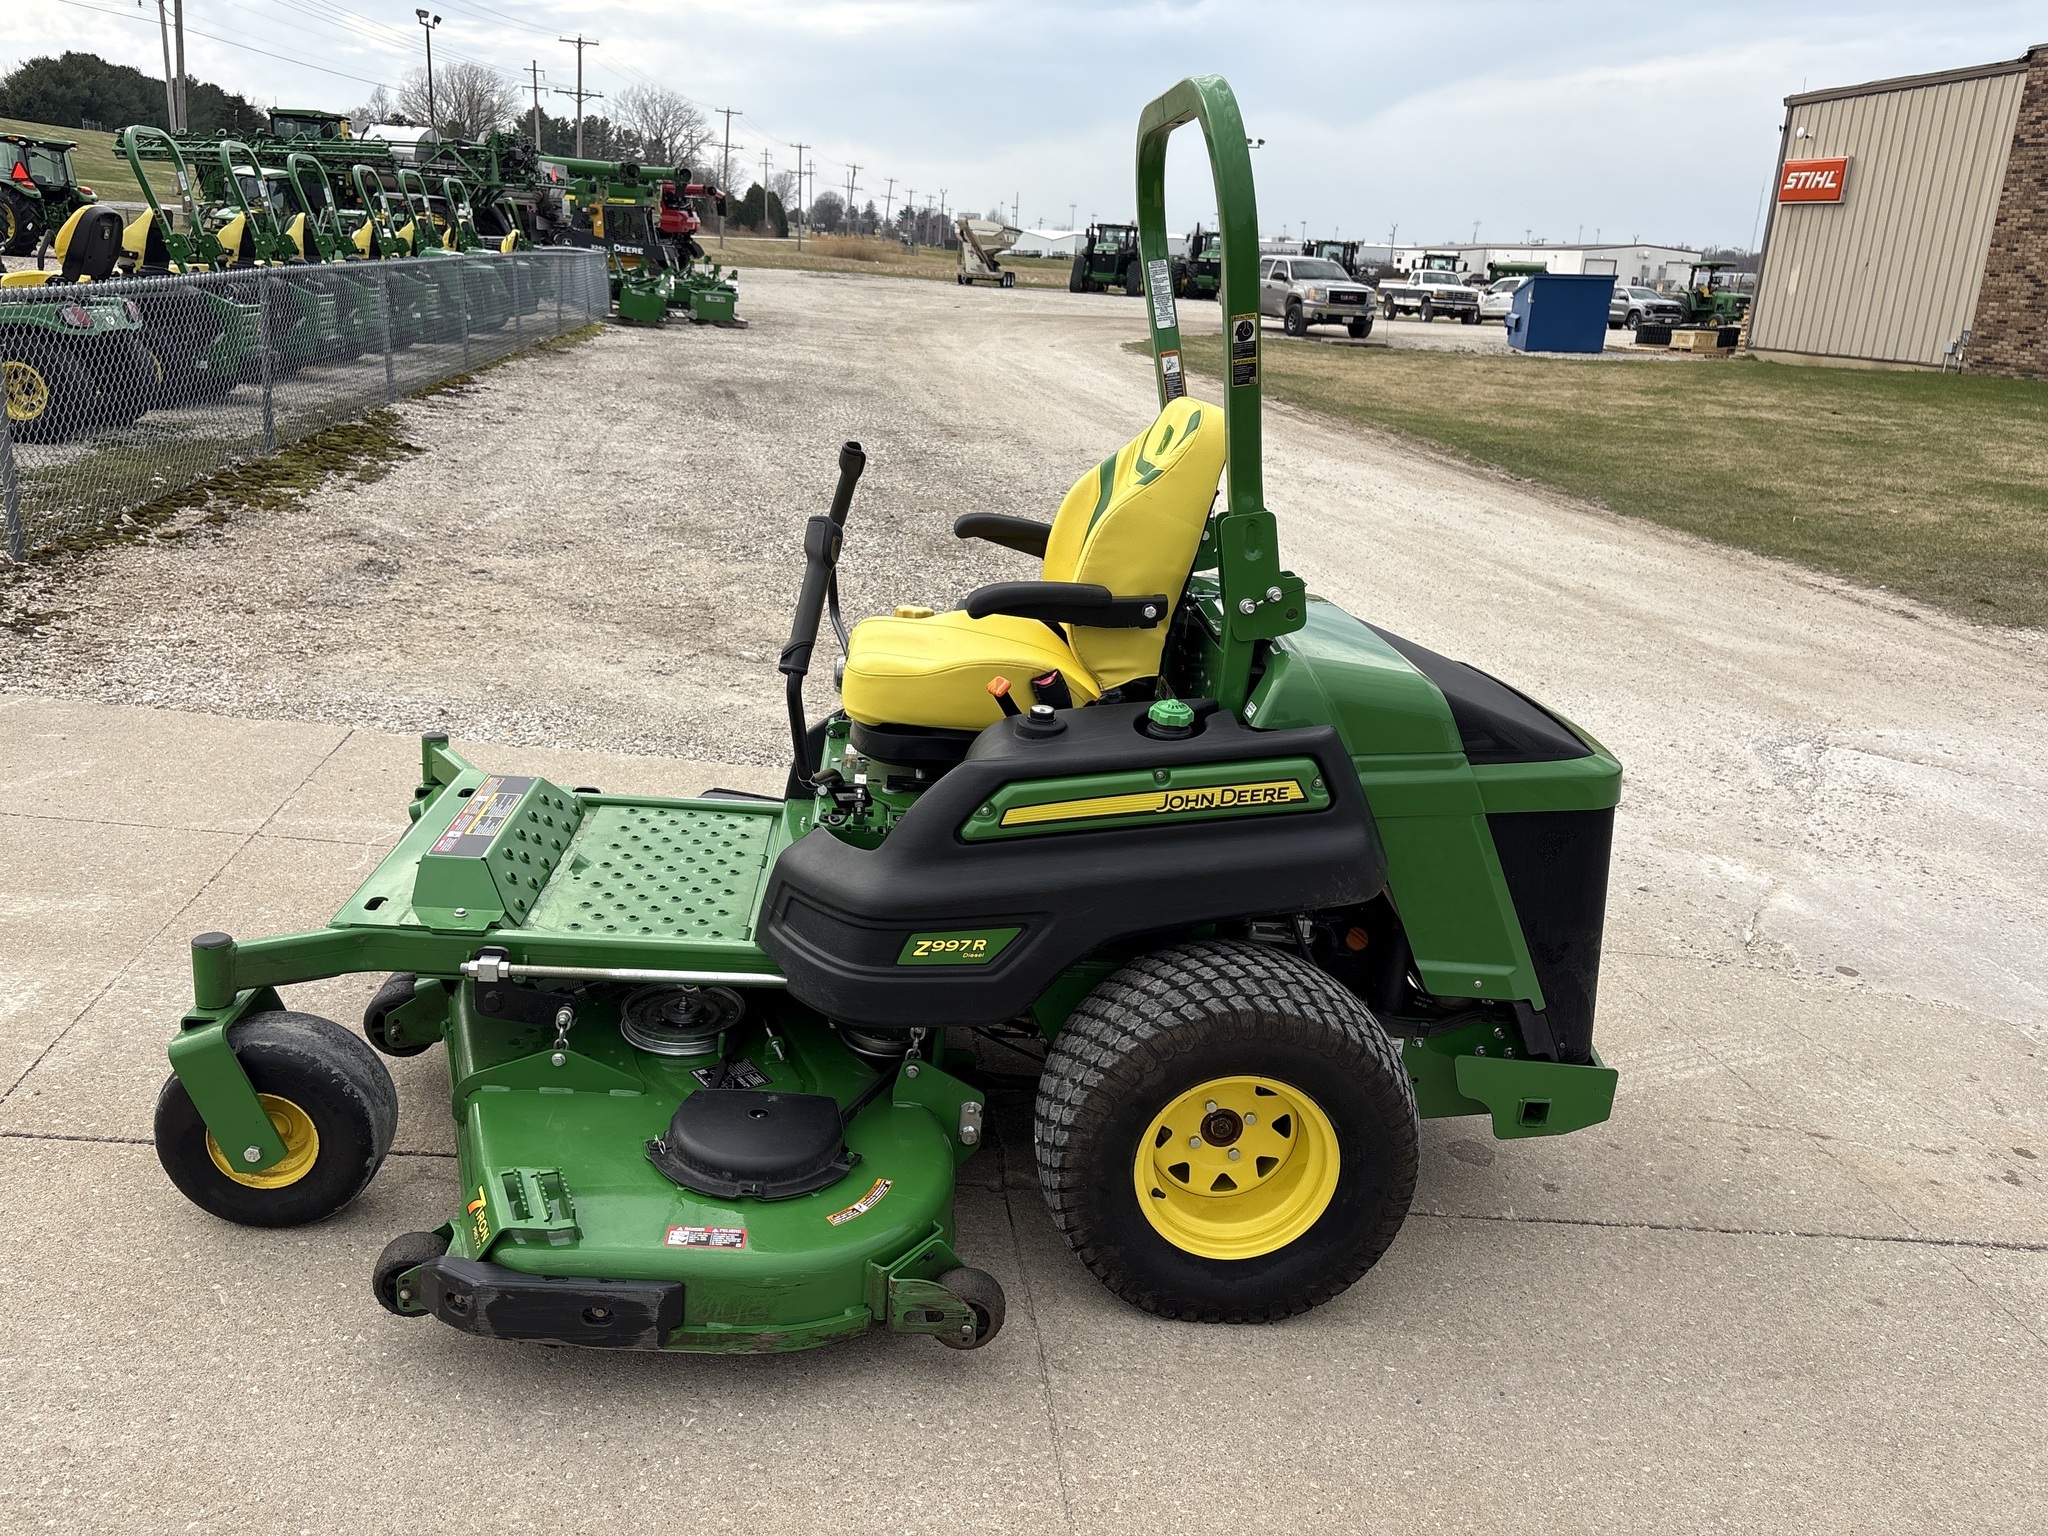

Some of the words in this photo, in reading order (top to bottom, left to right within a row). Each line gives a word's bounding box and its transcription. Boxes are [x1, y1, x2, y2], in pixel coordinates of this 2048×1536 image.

[1783, 170, 1837, 190] STIHL
[613, 243, 644, 255] DEERE
[1156, 793, 1215, 811] JOHN
[1220, 786, 1290, 805] DEERE
[912, 940, 987, 956] Z997R
